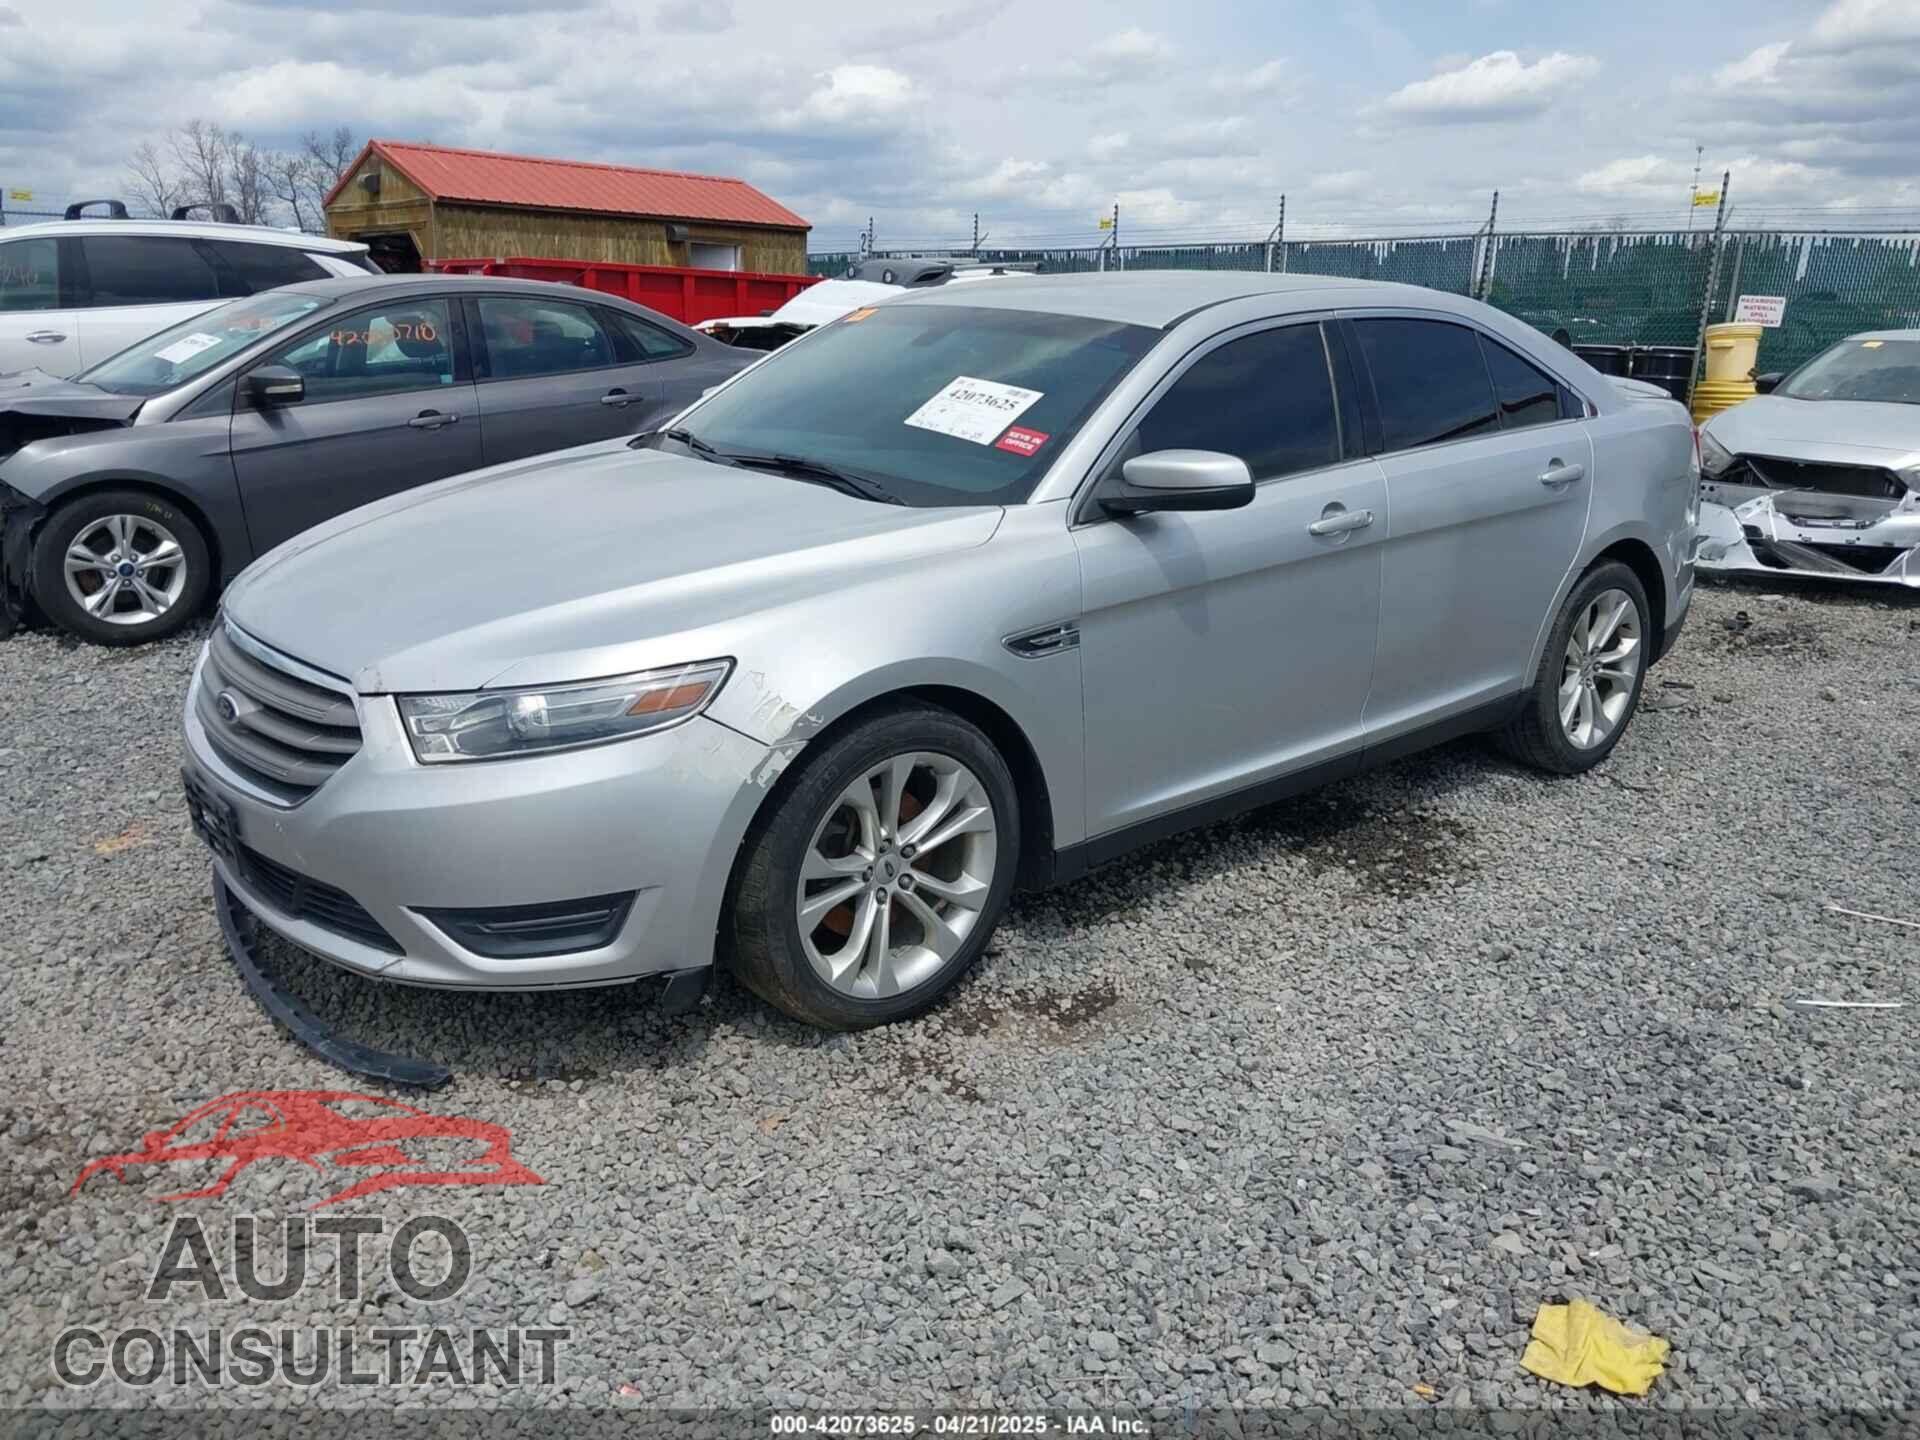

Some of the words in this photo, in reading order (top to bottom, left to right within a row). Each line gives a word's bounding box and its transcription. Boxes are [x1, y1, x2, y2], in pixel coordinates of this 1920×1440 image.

[949, 389, 1019, 411] 42073625
[1004, 439, 1035, 450] OFFICE
[1008, 431, 1031, 441] KEYS
[1031, 435, 1043, 445] IN
